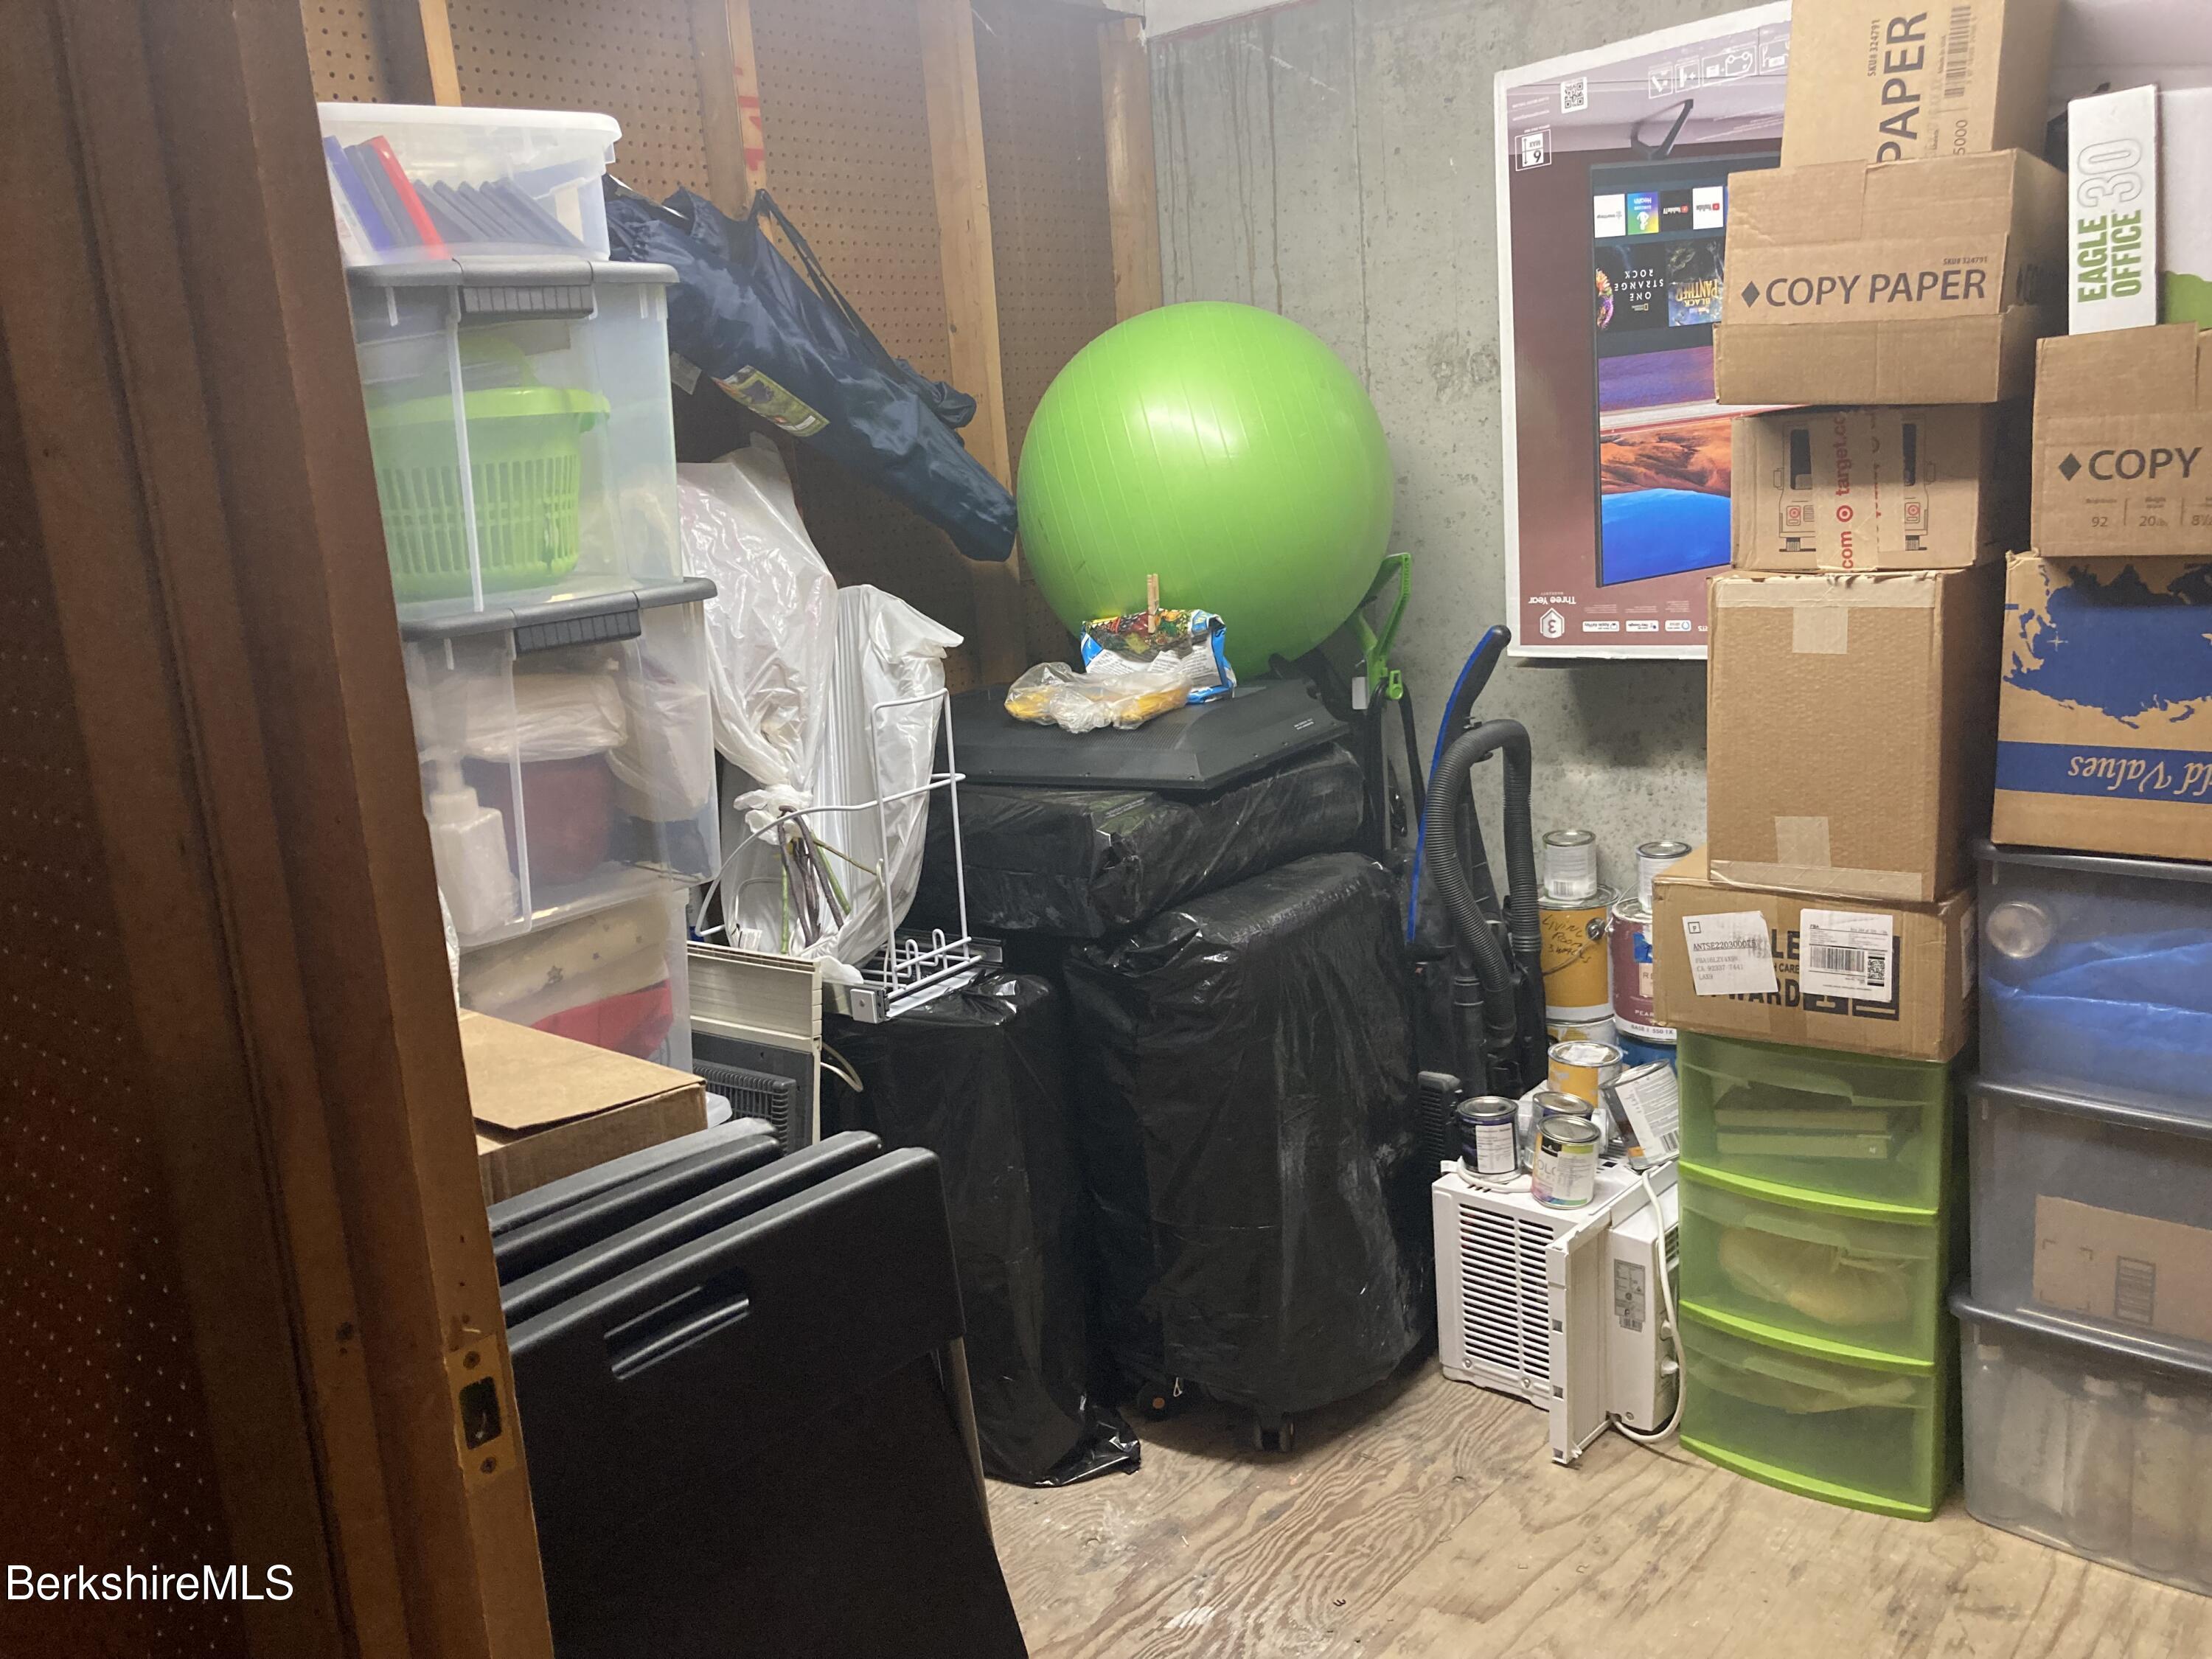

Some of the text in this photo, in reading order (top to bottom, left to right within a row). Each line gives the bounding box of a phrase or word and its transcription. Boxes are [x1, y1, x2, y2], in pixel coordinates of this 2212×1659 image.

[1877, 12, 1928, 163] PAPER
[1954, 119, 1968, 155] 5000
[2077, 139, 2143, 208] 30
[2077, 215, 2107, 303] EAGLE
[2111, 209, 2142, 298] OFFICE
[1614, 279, 1664, 291] STRANGE
[1624, 268, 1654, 279] ROCK
[1629, 292, 1652, 302] ONE
[1766, 269, 1986, 307] COPY PAPER
[1684, 298, 1711, 307] BLACK
[2088, 447, 2203, 481] COPY
[2091, 516, 2108, 527] 92
[1528, 596, 1577, 605] Three Year
[1548, 619, 1557, 633] 3
[2067, 756, 2171, 793] Values
[1779, 963, 1800, 973] CARE
